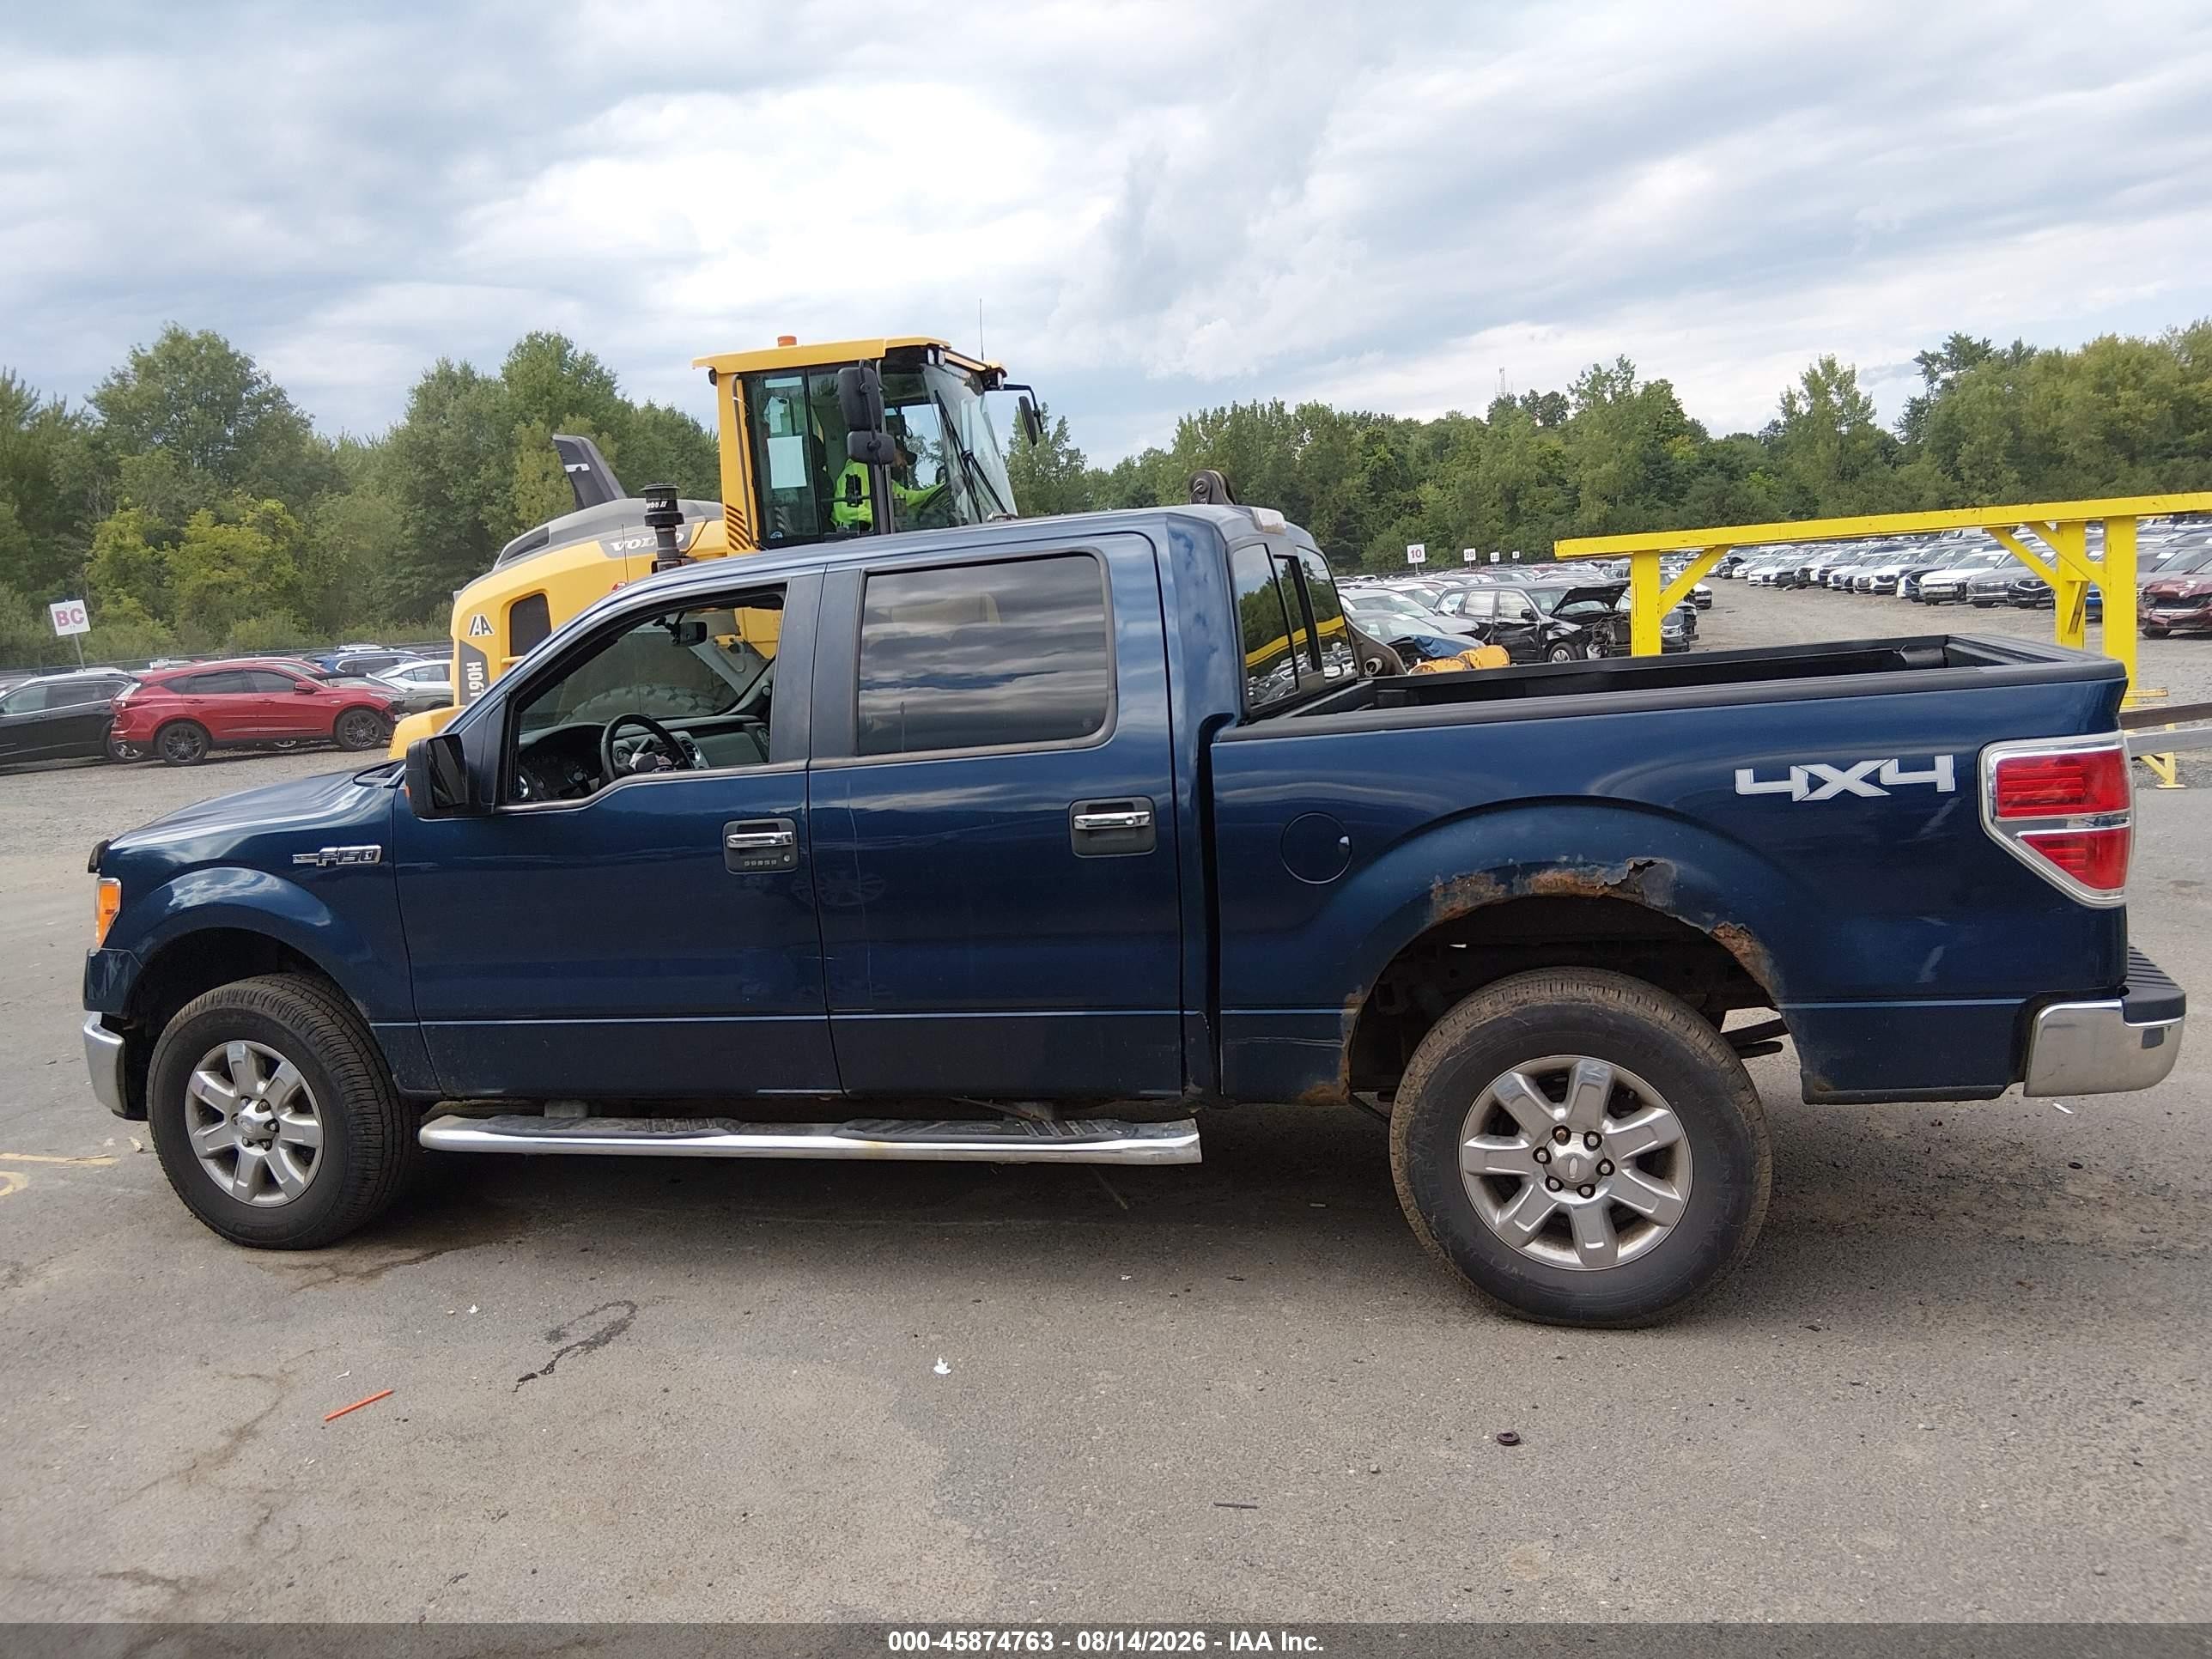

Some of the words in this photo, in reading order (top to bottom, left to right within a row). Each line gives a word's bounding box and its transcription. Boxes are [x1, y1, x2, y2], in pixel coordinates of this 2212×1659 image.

[611, 532, 684, 551] VOLO
[1411, 550, 1422, 558] 10
[55, 608, 85, 627] BC
[293, 845, 382, 867] F-150
